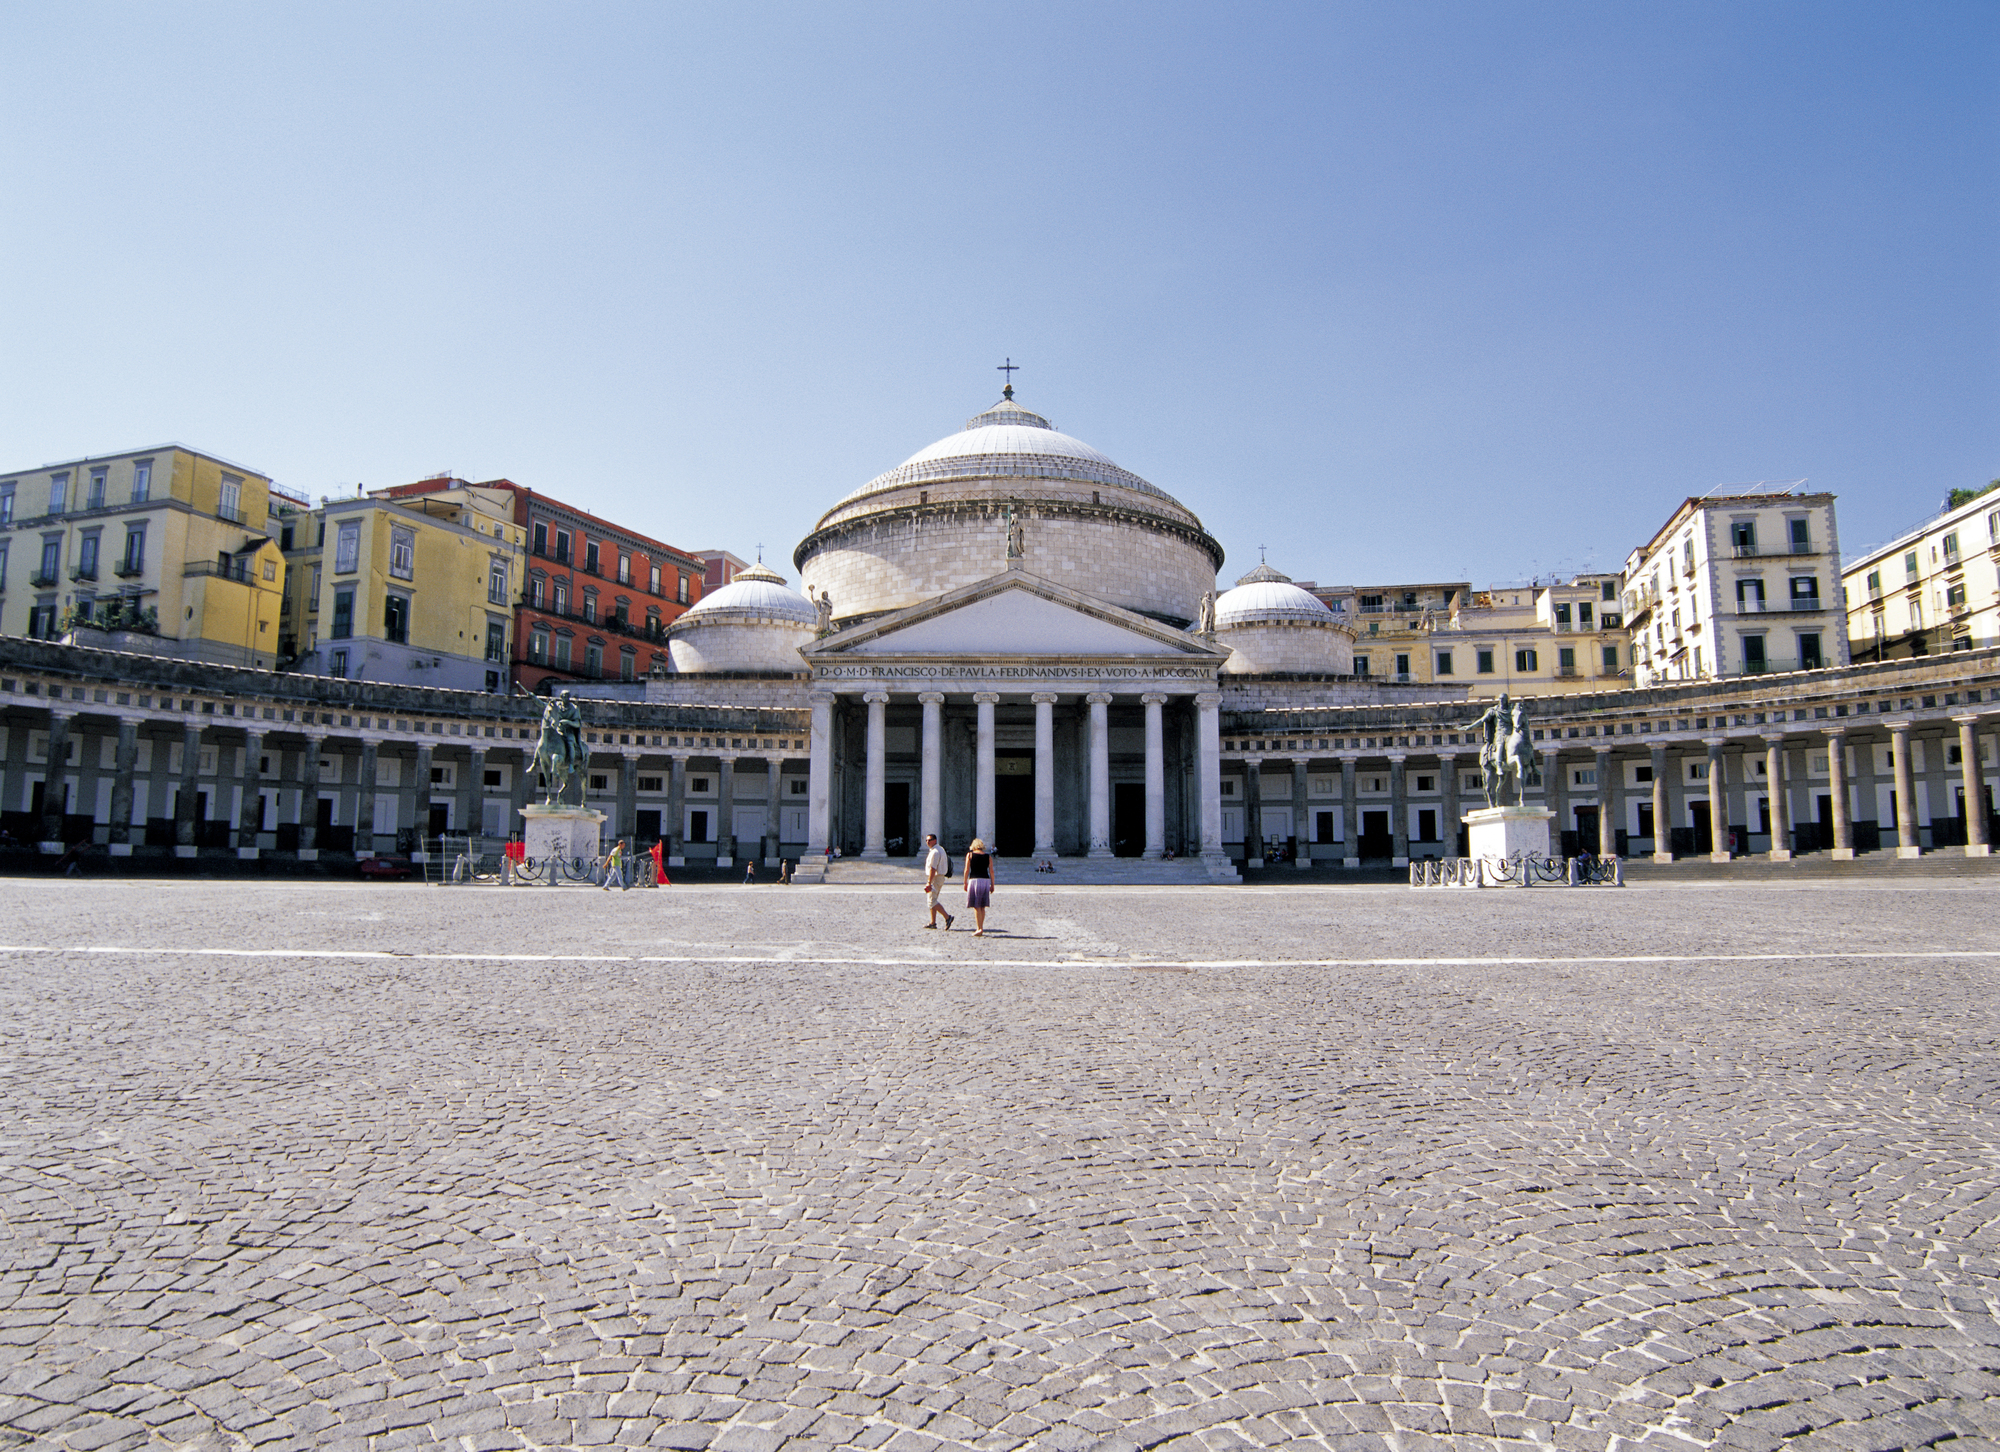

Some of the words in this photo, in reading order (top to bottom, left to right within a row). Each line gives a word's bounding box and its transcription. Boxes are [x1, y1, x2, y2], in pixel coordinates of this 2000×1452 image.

[872, 667, 937, 676] FRANCISCO
[941, 667, 956, 676] DE
[960, 667, 996, 676] PAVLA
[1000, 667, 1078, 677] FERDINANDVS
[1087, 667, 1101, 677] EX
[1105, 667, 1138, 677] VOTO
